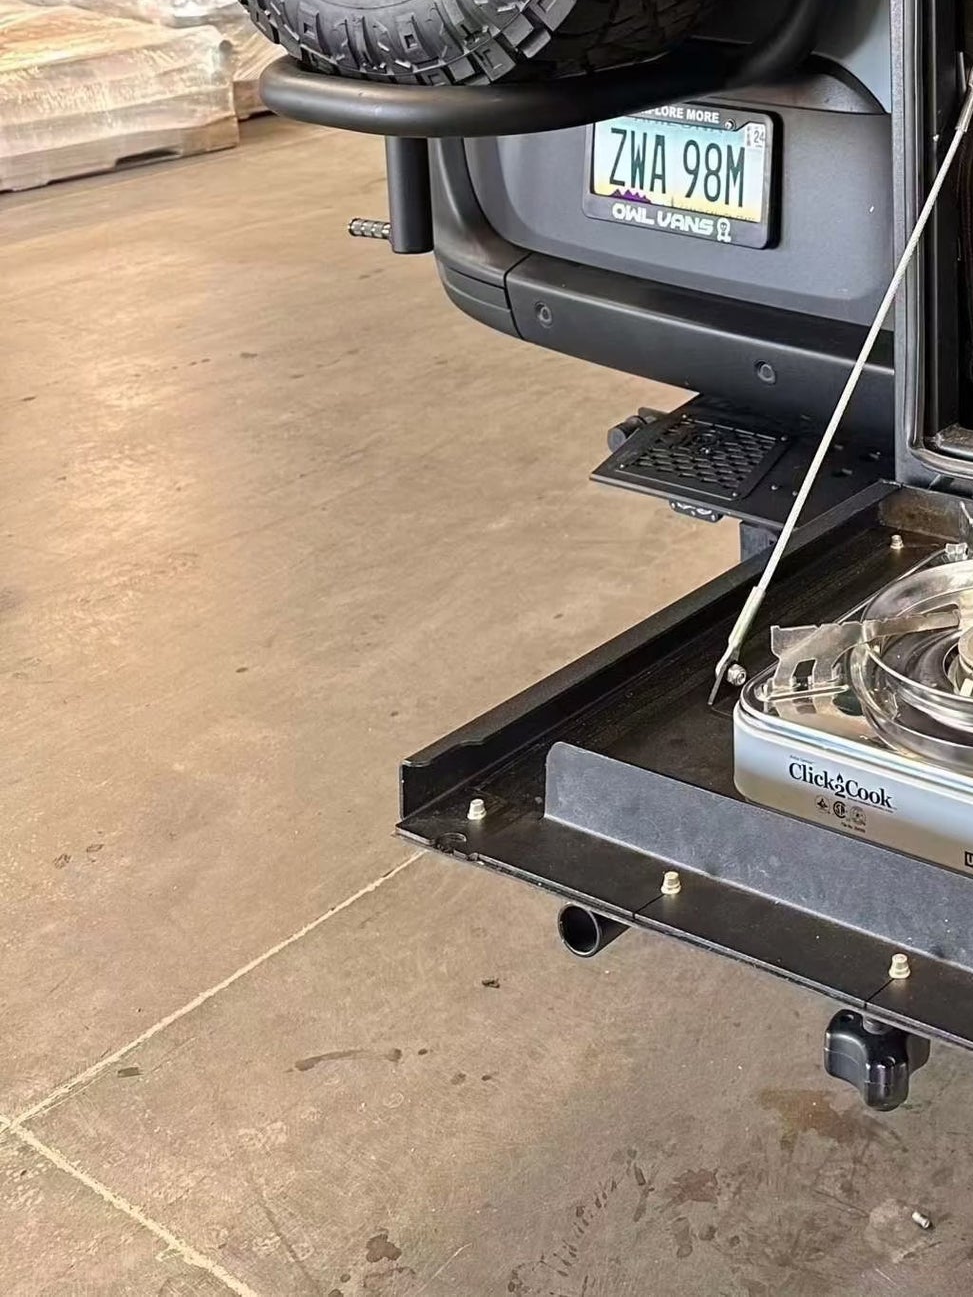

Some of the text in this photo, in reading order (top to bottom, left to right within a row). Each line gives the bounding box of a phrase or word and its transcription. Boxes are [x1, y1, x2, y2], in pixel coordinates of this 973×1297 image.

[640, 105, 720, 123] LORE MORE
[609, 127, 745, 208] ZWA 98M
[612, 202, 655, 225] OWL
[657, 210, 714, 235] VANS
